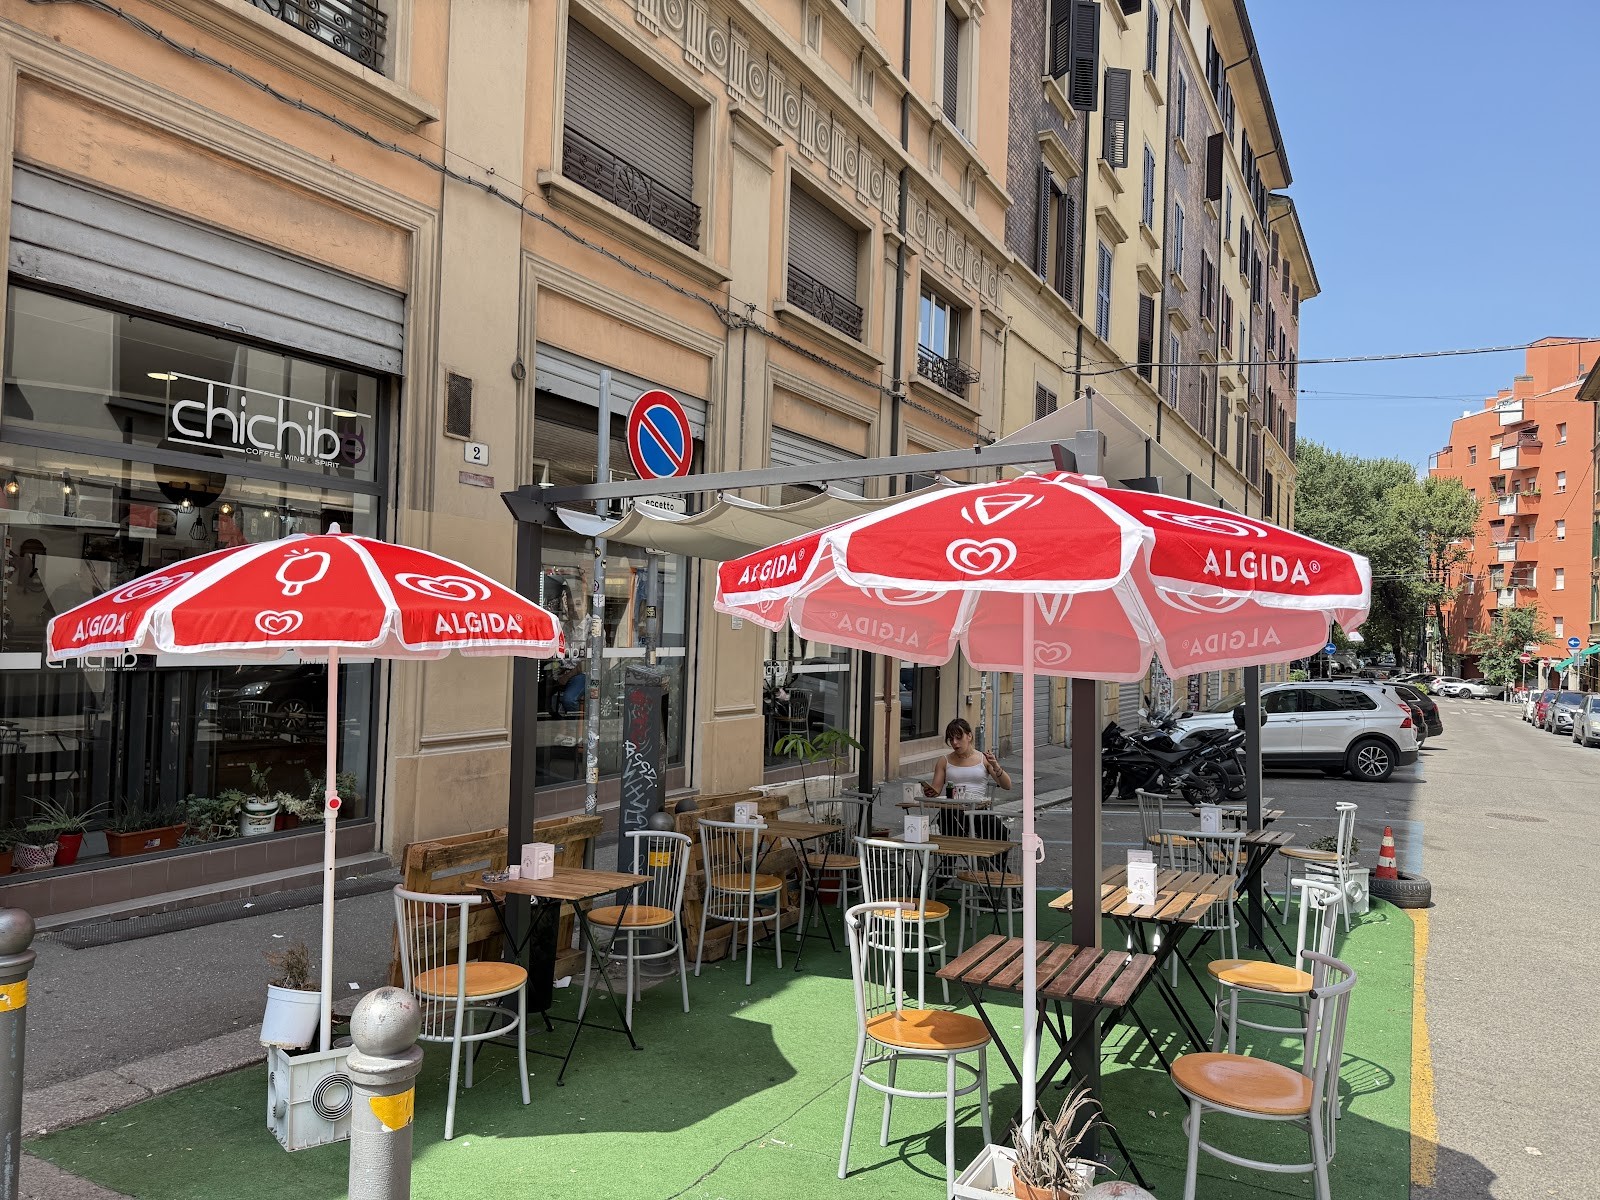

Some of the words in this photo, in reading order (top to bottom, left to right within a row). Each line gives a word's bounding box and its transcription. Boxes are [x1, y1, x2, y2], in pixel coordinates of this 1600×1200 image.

[284, 453, 306, 463] WINE
[314, 459, 340, 468] SPIRIT
[473, 446, 481, 461] 2
[645, 499, 675, 511] eccetto
